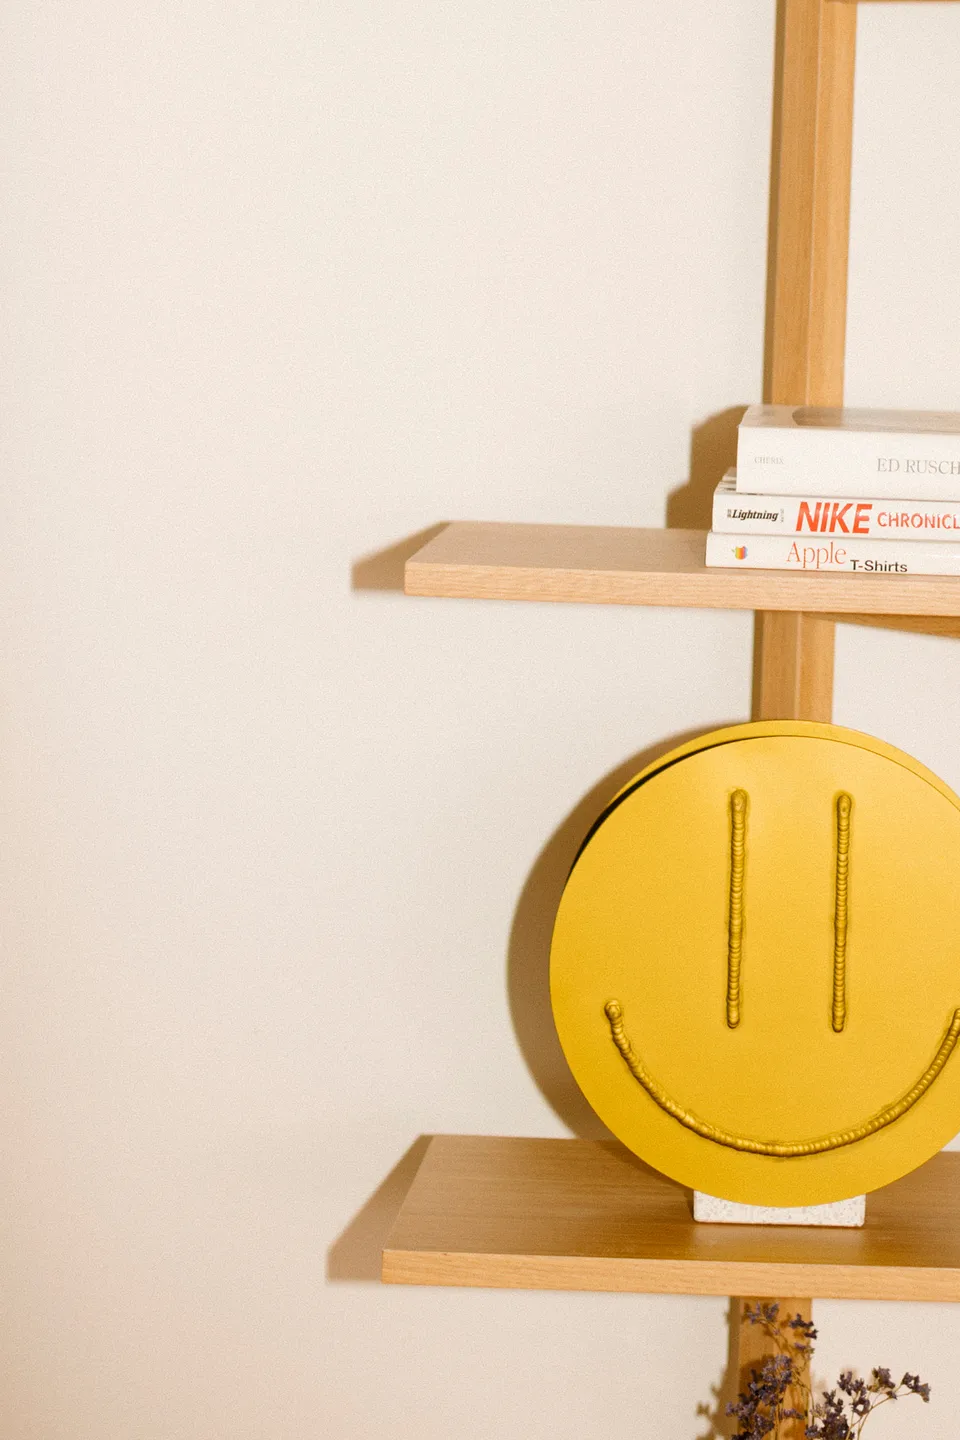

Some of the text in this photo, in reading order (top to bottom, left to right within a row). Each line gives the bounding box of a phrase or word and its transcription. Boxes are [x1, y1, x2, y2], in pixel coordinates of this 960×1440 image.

[754, 456, 785, 465] CHERIX
[877, 457, 900, 473] ED
[732, 509, 779, 522] Lightning
[795, 501, 873, 534] NIKE
[786, 541, 909, 573] Apple T-Shirts
